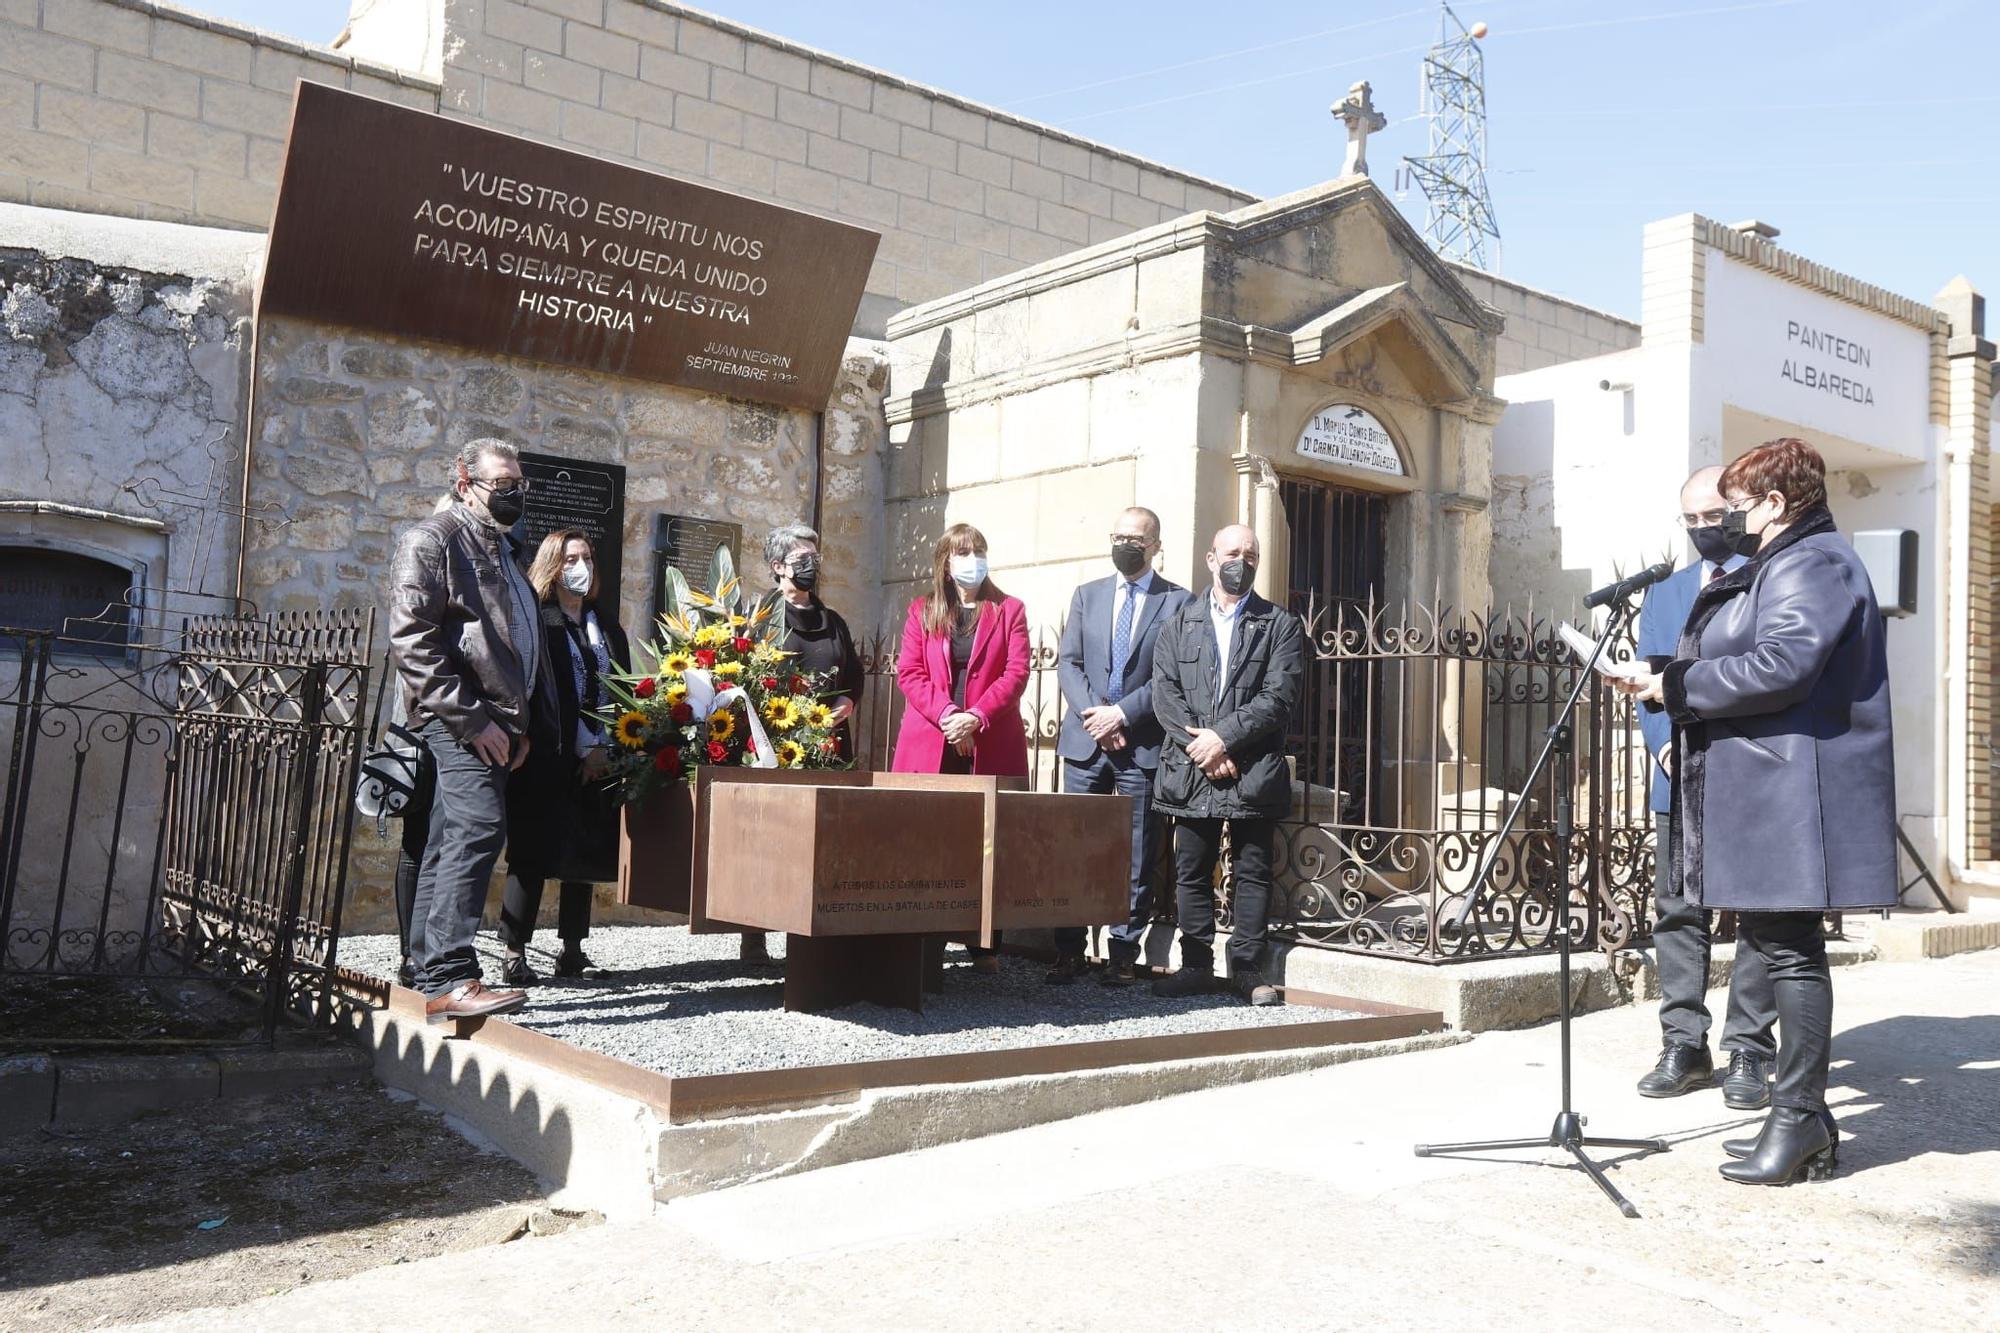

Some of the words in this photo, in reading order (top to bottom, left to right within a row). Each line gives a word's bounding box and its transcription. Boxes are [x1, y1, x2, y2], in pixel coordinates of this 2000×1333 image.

[461, 167, 589, 219] VUESTRO
[594, 201, 708, 247] ESPIRITU
[712, 231, 764, 261] NOS
[413, 199, 570, 255] ACOMPAÑA
[580, 235, 597, 258] Y
[601, 242, 687, 280] QUEDA
[694, 262, 768, 297] UNIDO
[414, 233, 489, 271] PARA
[496, 252, 614, 296] SIEMPRE
[616, 279, 634, 301] A
[640, 282, 750, 326] NUESTRA
[517, 289, 635, 333] HISTORIA
[703, 341, 739, 359] JUAN
[740, 348, 792, 369] NEGRIN
[1787, 320, 1871, 368] PANTEON
[685, 354, 769, 382] SEPTIEMBRE
[1780, 358, 1875, 407] ALBAREDA
[1312, 438, 1339, 458] CARMEN
[816, 902, 864, 913] MUERTOS
[866, 901, 880, 912] EN
[881, 901, 893, 912] LA
[895, 900, 934, 911] BATALLA
[936, 900, 948, 910] DE
[841, 880, 873, 890] TODOS
[877, 880, 896, 890] LOS
[899, 879, 968, 890] COMBATIENTES
